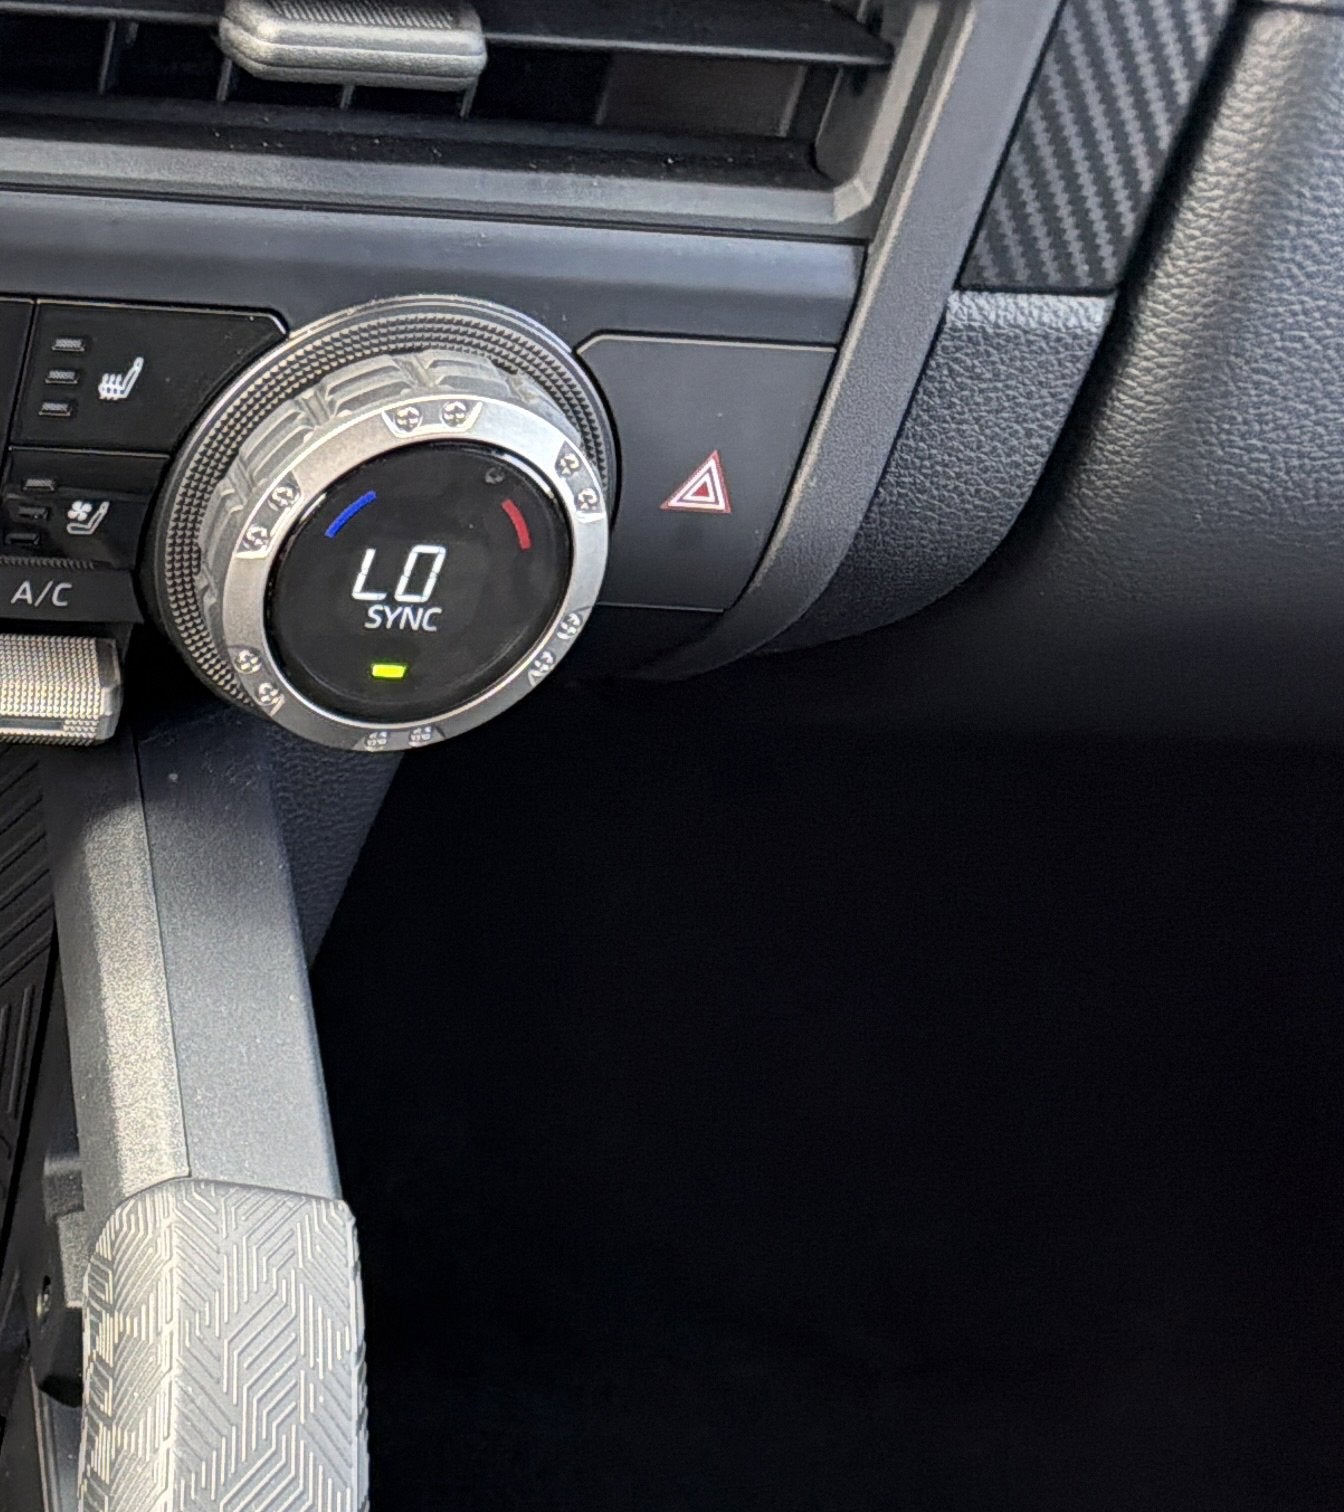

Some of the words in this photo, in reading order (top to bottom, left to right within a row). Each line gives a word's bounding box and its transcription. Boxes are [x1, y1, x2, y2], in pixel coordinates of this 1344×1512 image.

[353, 546, 447, 602] LO
[11, 581, 73, 608] A/C
[364, 606, 443, 632] SYNC
